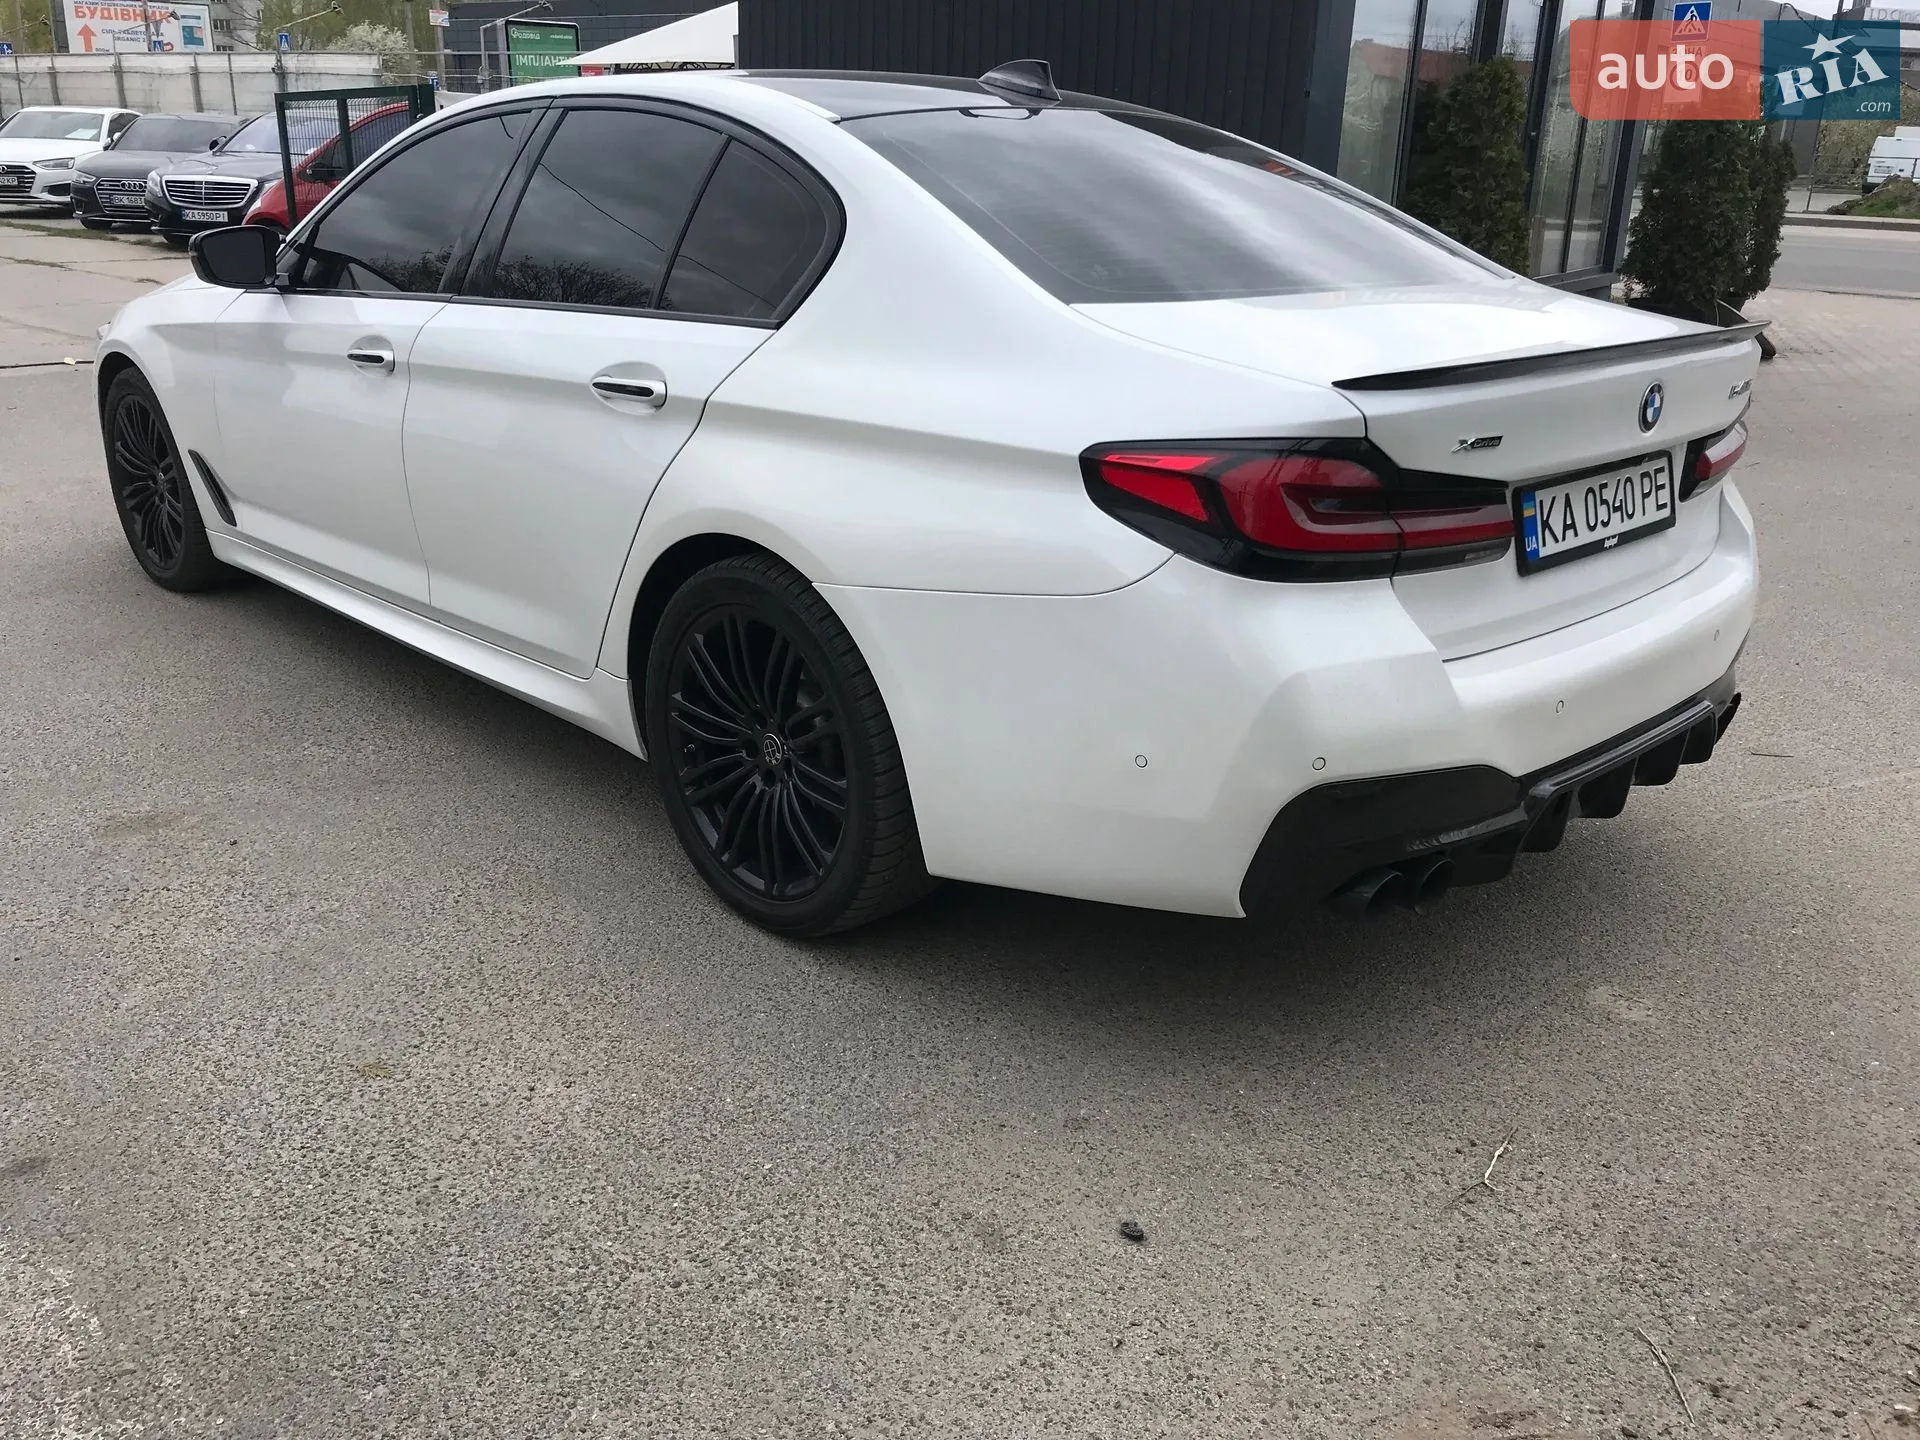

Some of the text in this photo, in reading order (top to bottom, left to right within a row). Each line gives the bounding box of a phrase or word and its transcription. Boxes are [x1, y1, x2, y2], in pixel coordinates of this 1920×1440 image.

[1540, 466, 1668, 547] KA 0540 PE
[1525, 536, 1538, 551] UA
